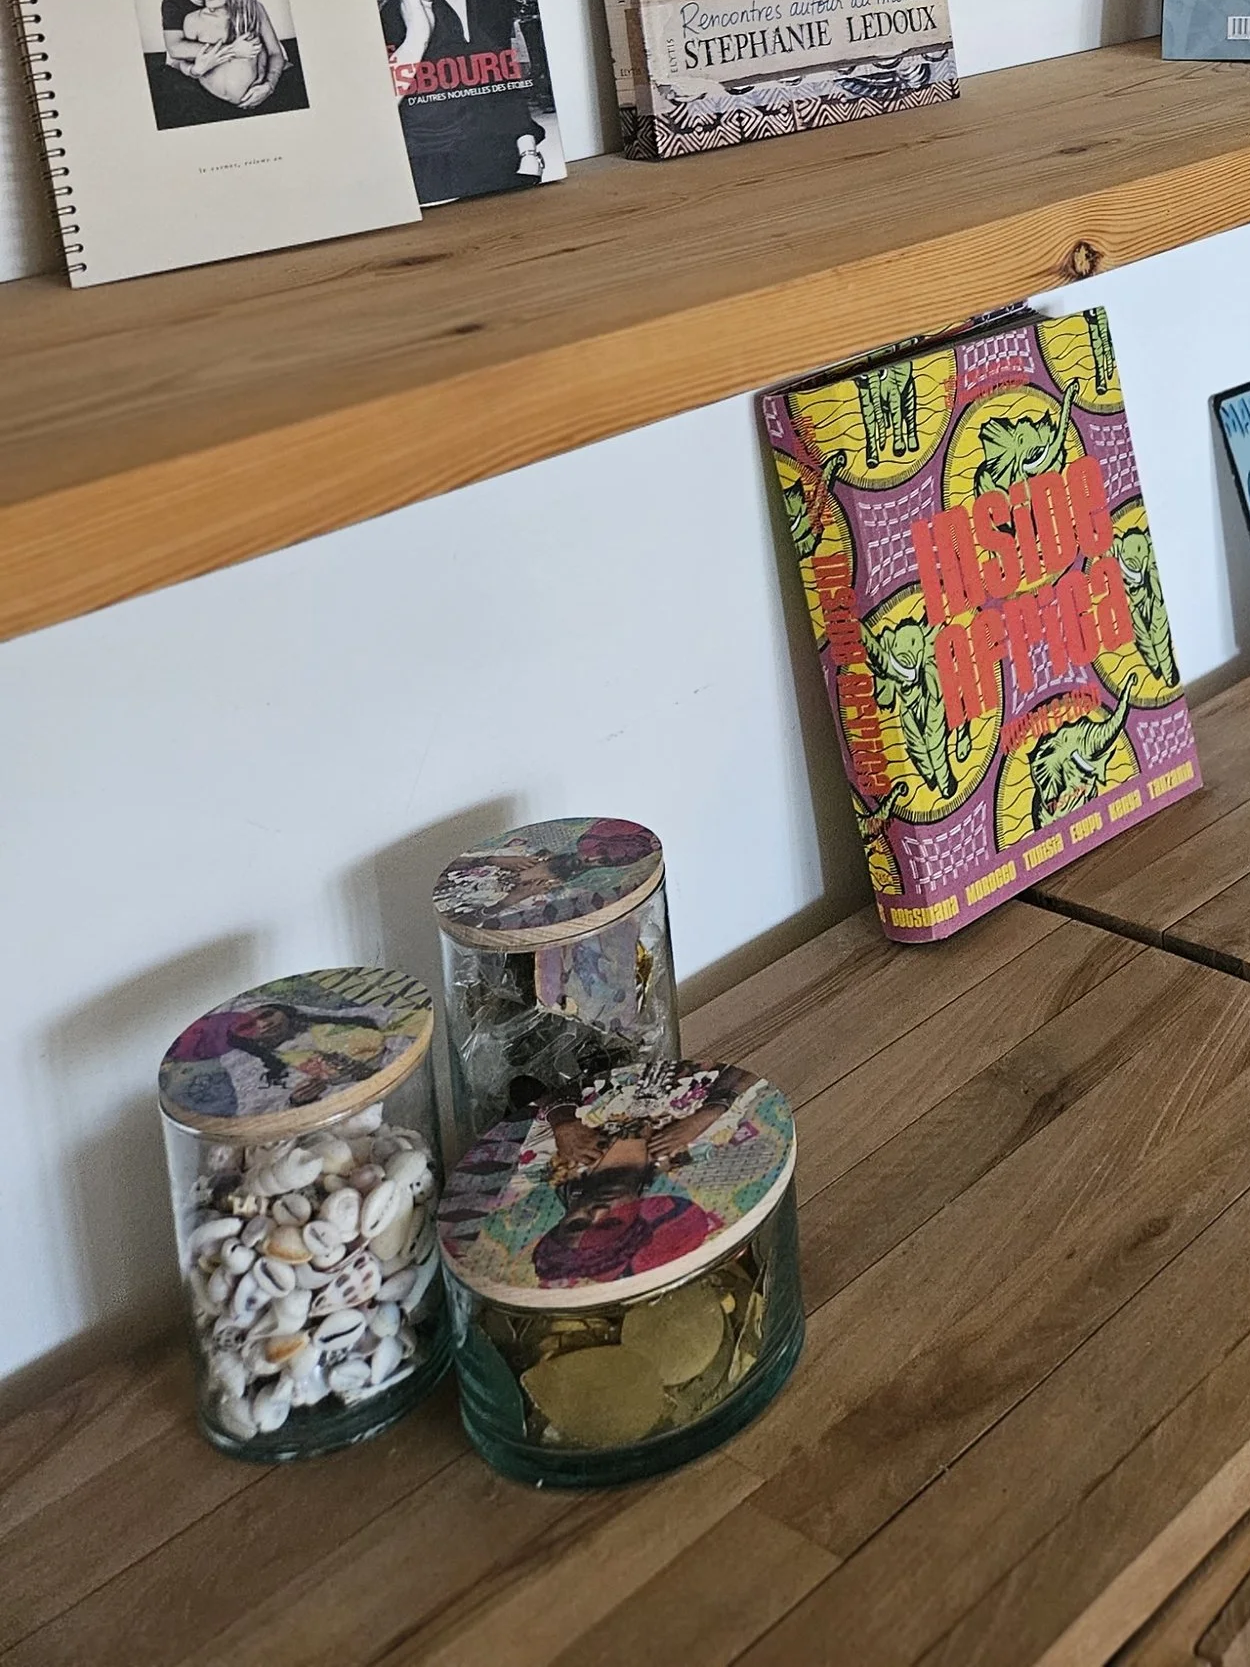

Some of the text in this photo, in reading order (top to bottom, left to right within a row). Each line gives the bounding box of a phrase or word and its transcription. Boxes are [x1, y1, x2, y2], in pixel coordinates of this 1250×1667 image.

[680, 1, 783, 38] Rencontres
[667, 38, 679, 73] ELYTIS
[684, 5, 938, 71] STEPHANIE LEDOUX
[408, 92, 447, 106] D'AUTRES
[447, 85, 491, 99] NOUVELLES
[493, 83, 507, 94] DES
